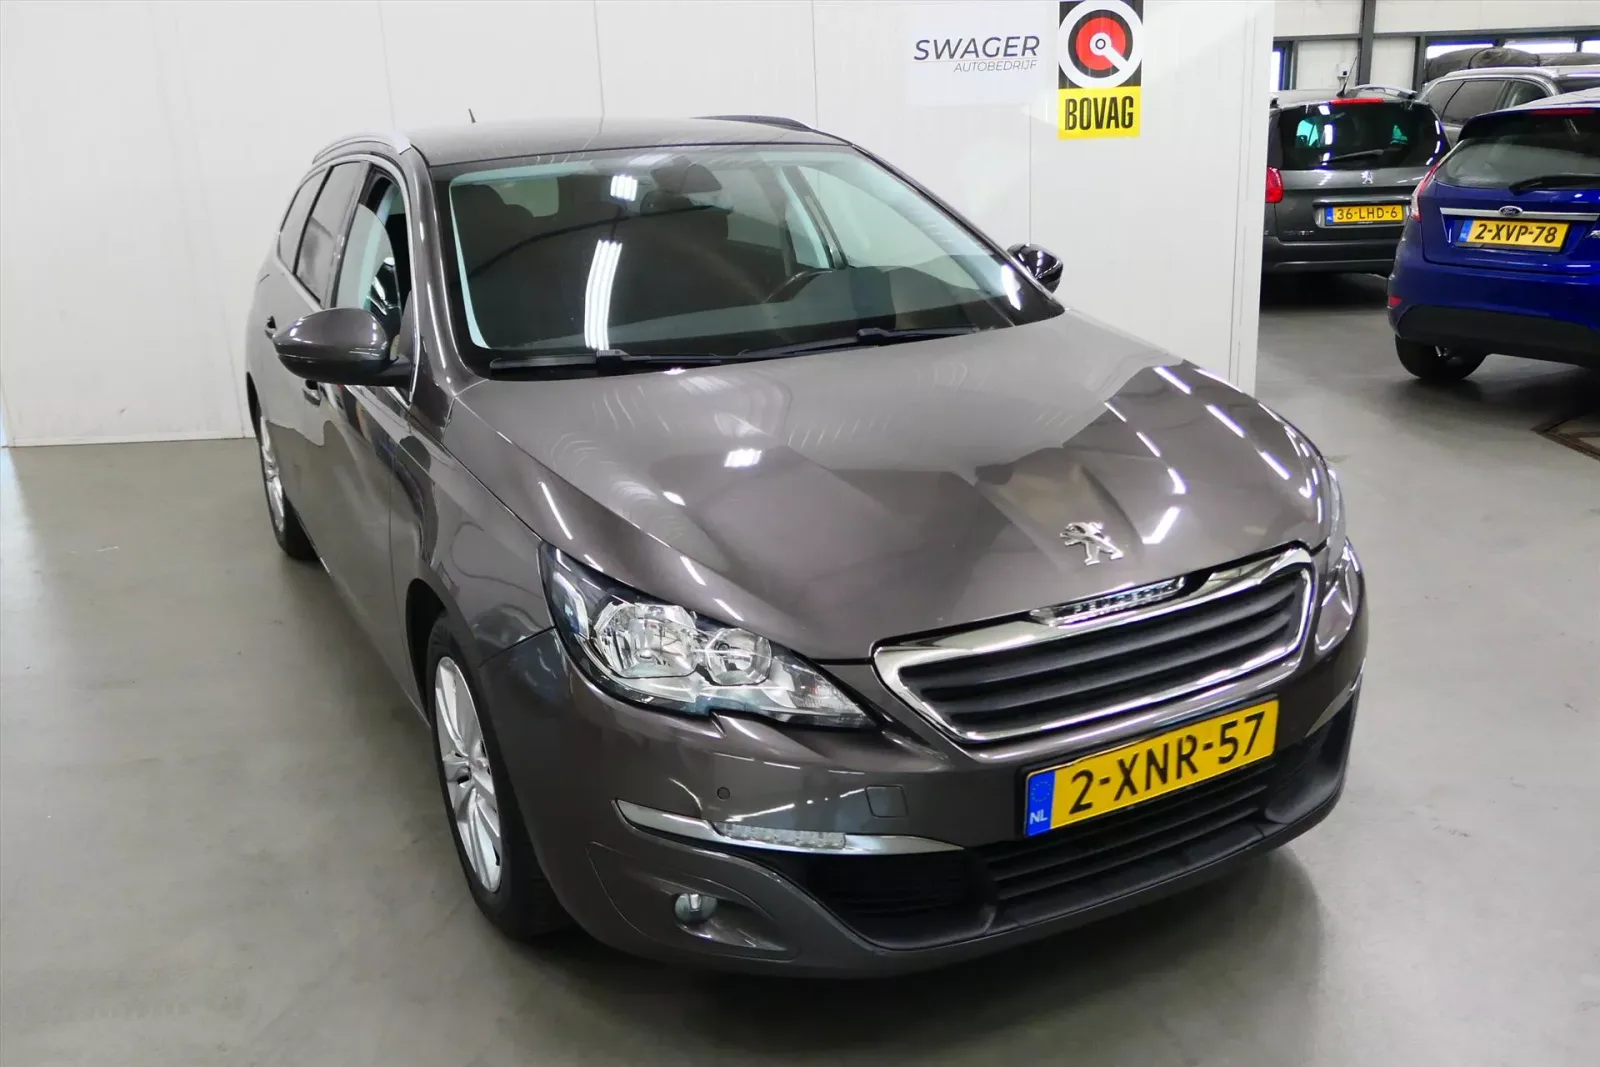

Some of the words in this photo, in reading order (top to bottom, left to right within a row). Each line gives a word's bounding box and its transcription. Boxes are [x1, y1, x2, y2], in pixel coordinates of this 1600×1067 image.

[913, 35, 1040, 61] SWAGER
[953, 59, 1037, 73] AUTOBEDRIJF
[1064, 95, 1134, 131] BOVAG
[1336, 206, 1398, 220] 36-LHD-6
[1474, 223, 1558, 243] 2-XVP-78
[1069, 711, 1265, 815] 2-XNR-57
[1029, 809, 1048, 825] NL
